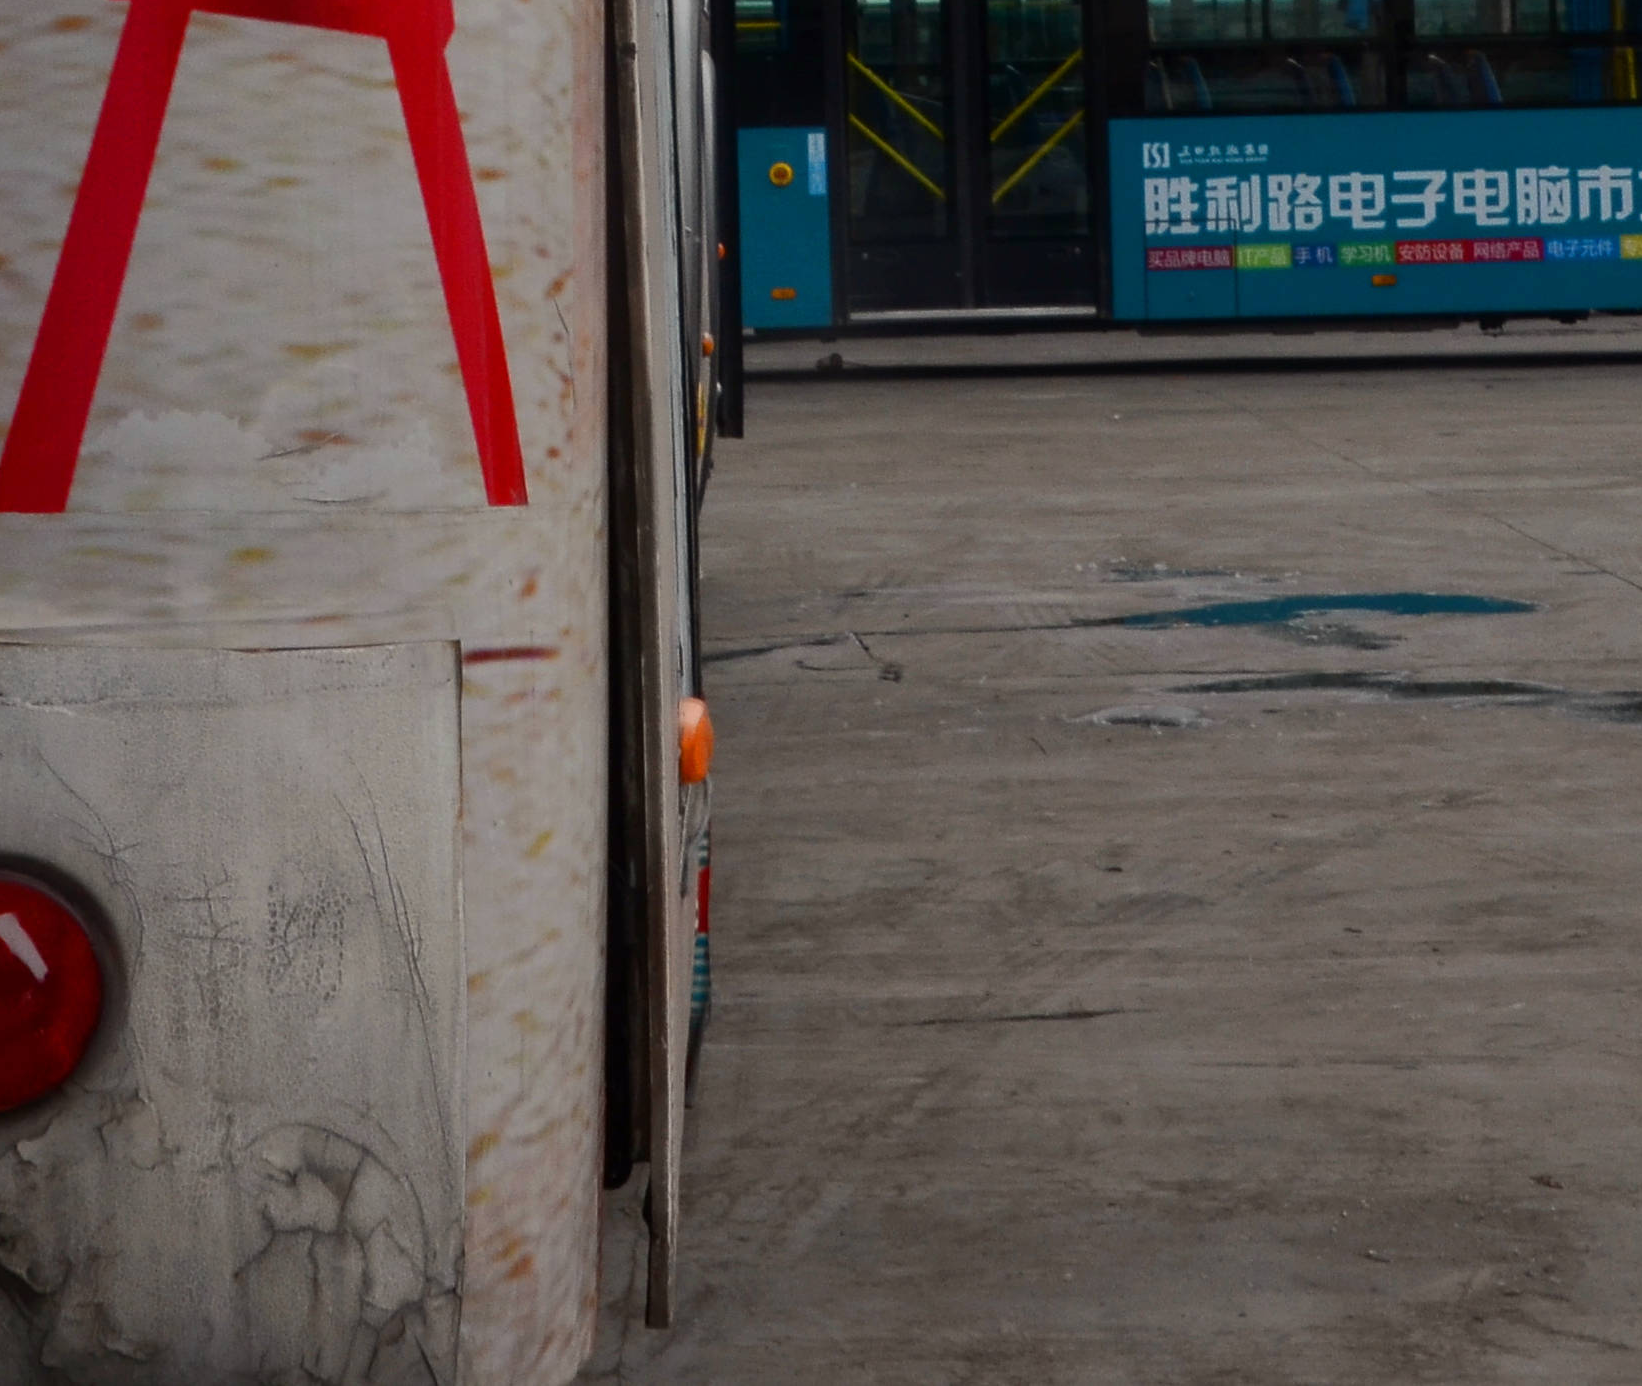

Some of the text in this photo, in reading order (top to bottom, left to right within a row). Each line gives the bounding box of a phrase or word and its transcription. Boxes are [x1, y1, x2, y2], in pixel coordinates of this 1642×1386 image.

[1295, 245, 1334, 263] 手机
[1341, 244, 1391, 264] 学习机
[1398, 241, 1464, 262] 安防设备
[1473, 239, 1540, 260] 网络产品
[1548, 237, 1613, 258] 电子元件
